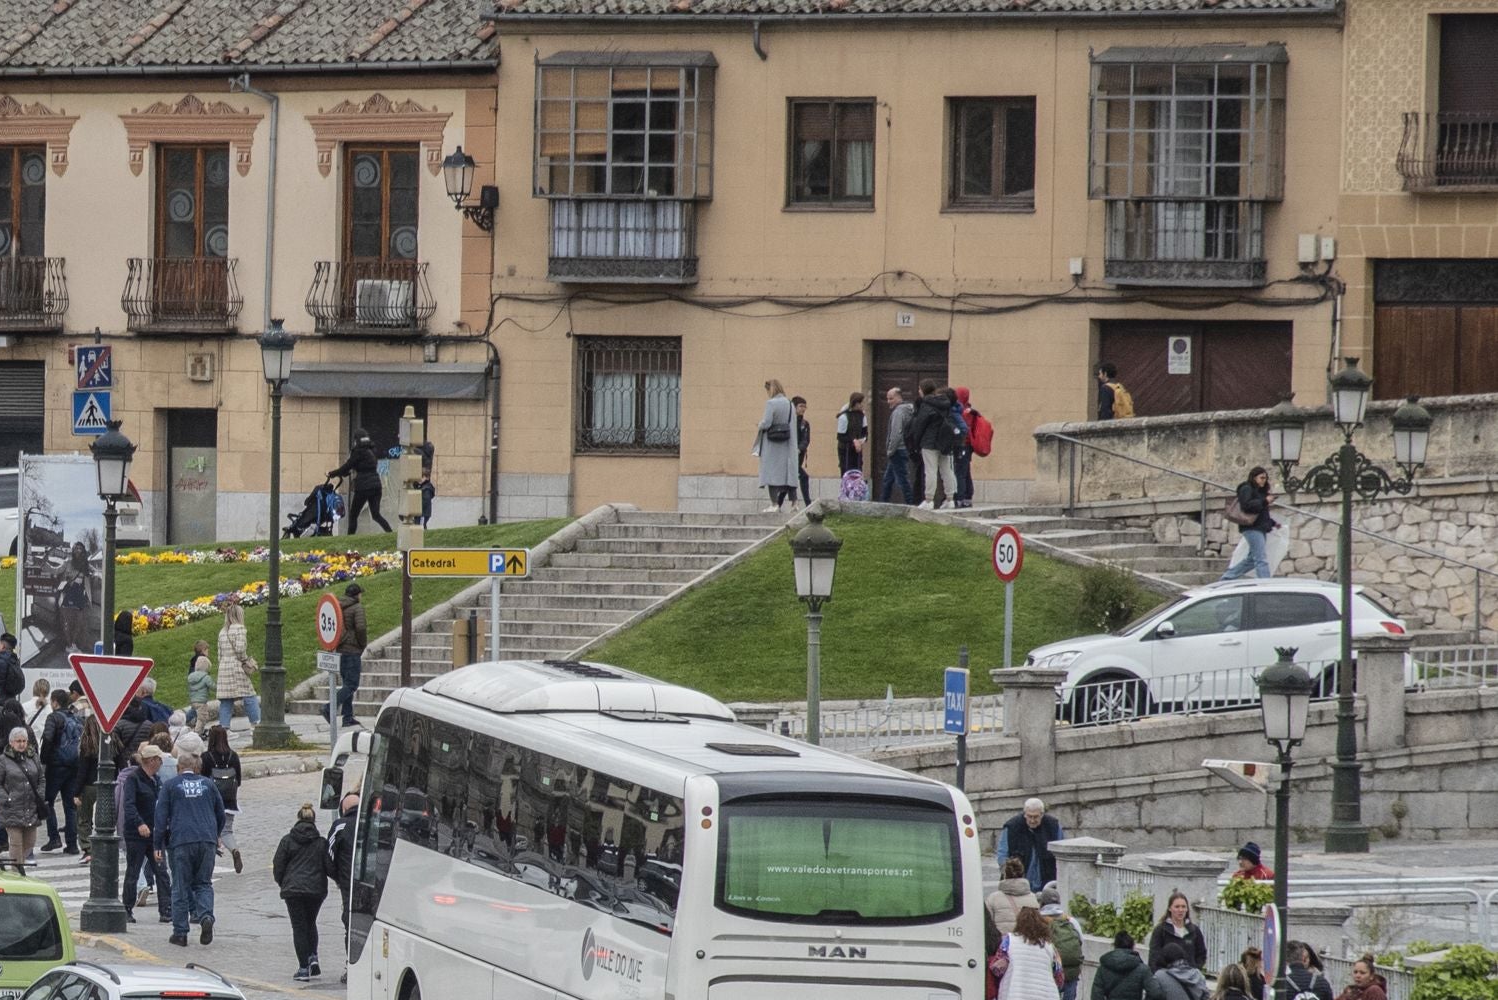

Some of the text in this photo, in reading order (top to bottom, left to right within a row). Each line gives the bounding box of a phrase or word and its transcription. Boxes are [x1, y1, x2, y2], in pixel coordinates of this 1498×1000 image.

[999, 544, 1014, 564] 50
[412, 558, 456, 568] Catedral
[947, 692, 965, 712] TAXI
[767, 864, 913, 877] www.valedoavetransportes.pt
[947, 926, 963, 937] 116
[808, 945, 867, 959] MAN
[615, 953, 627, 976] DO
